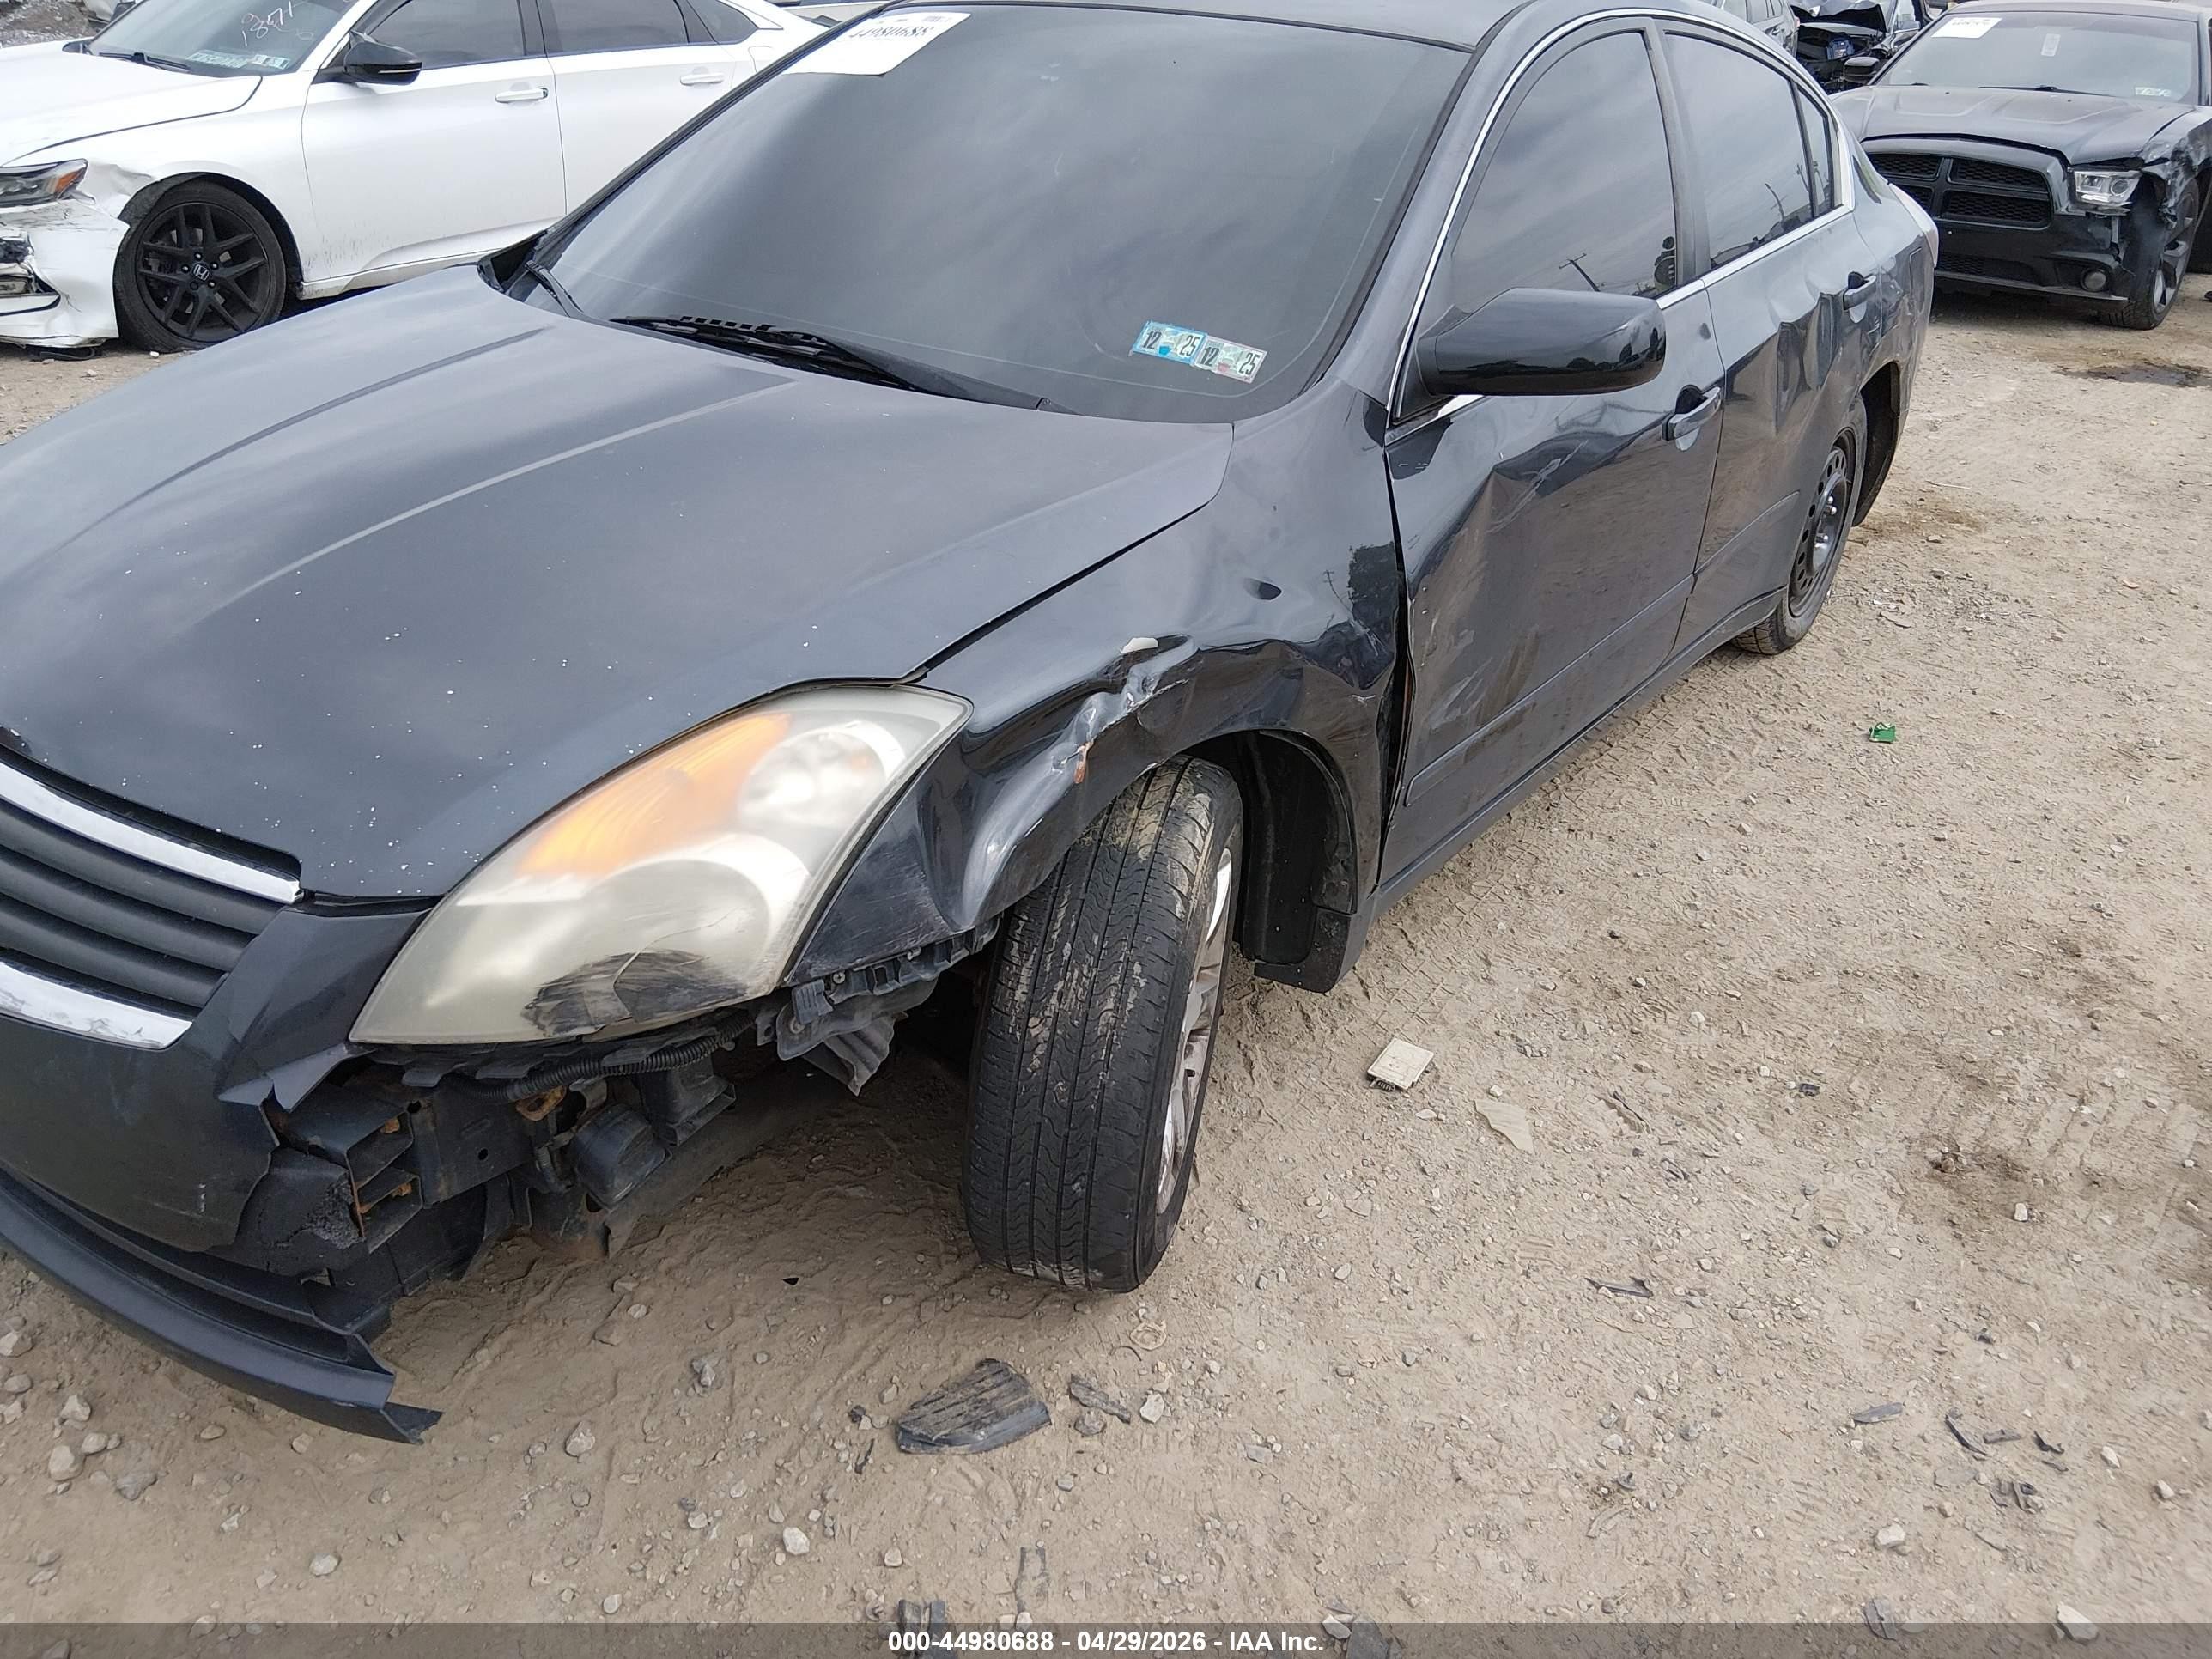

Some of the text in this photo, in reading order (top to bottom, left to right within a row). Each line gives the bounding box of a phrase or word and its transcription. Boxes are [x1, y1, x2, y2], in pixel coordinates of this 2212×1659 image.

[1142, 331, 1200, 357] 12 25
[1200, 346, 1261, 375] 12 25
